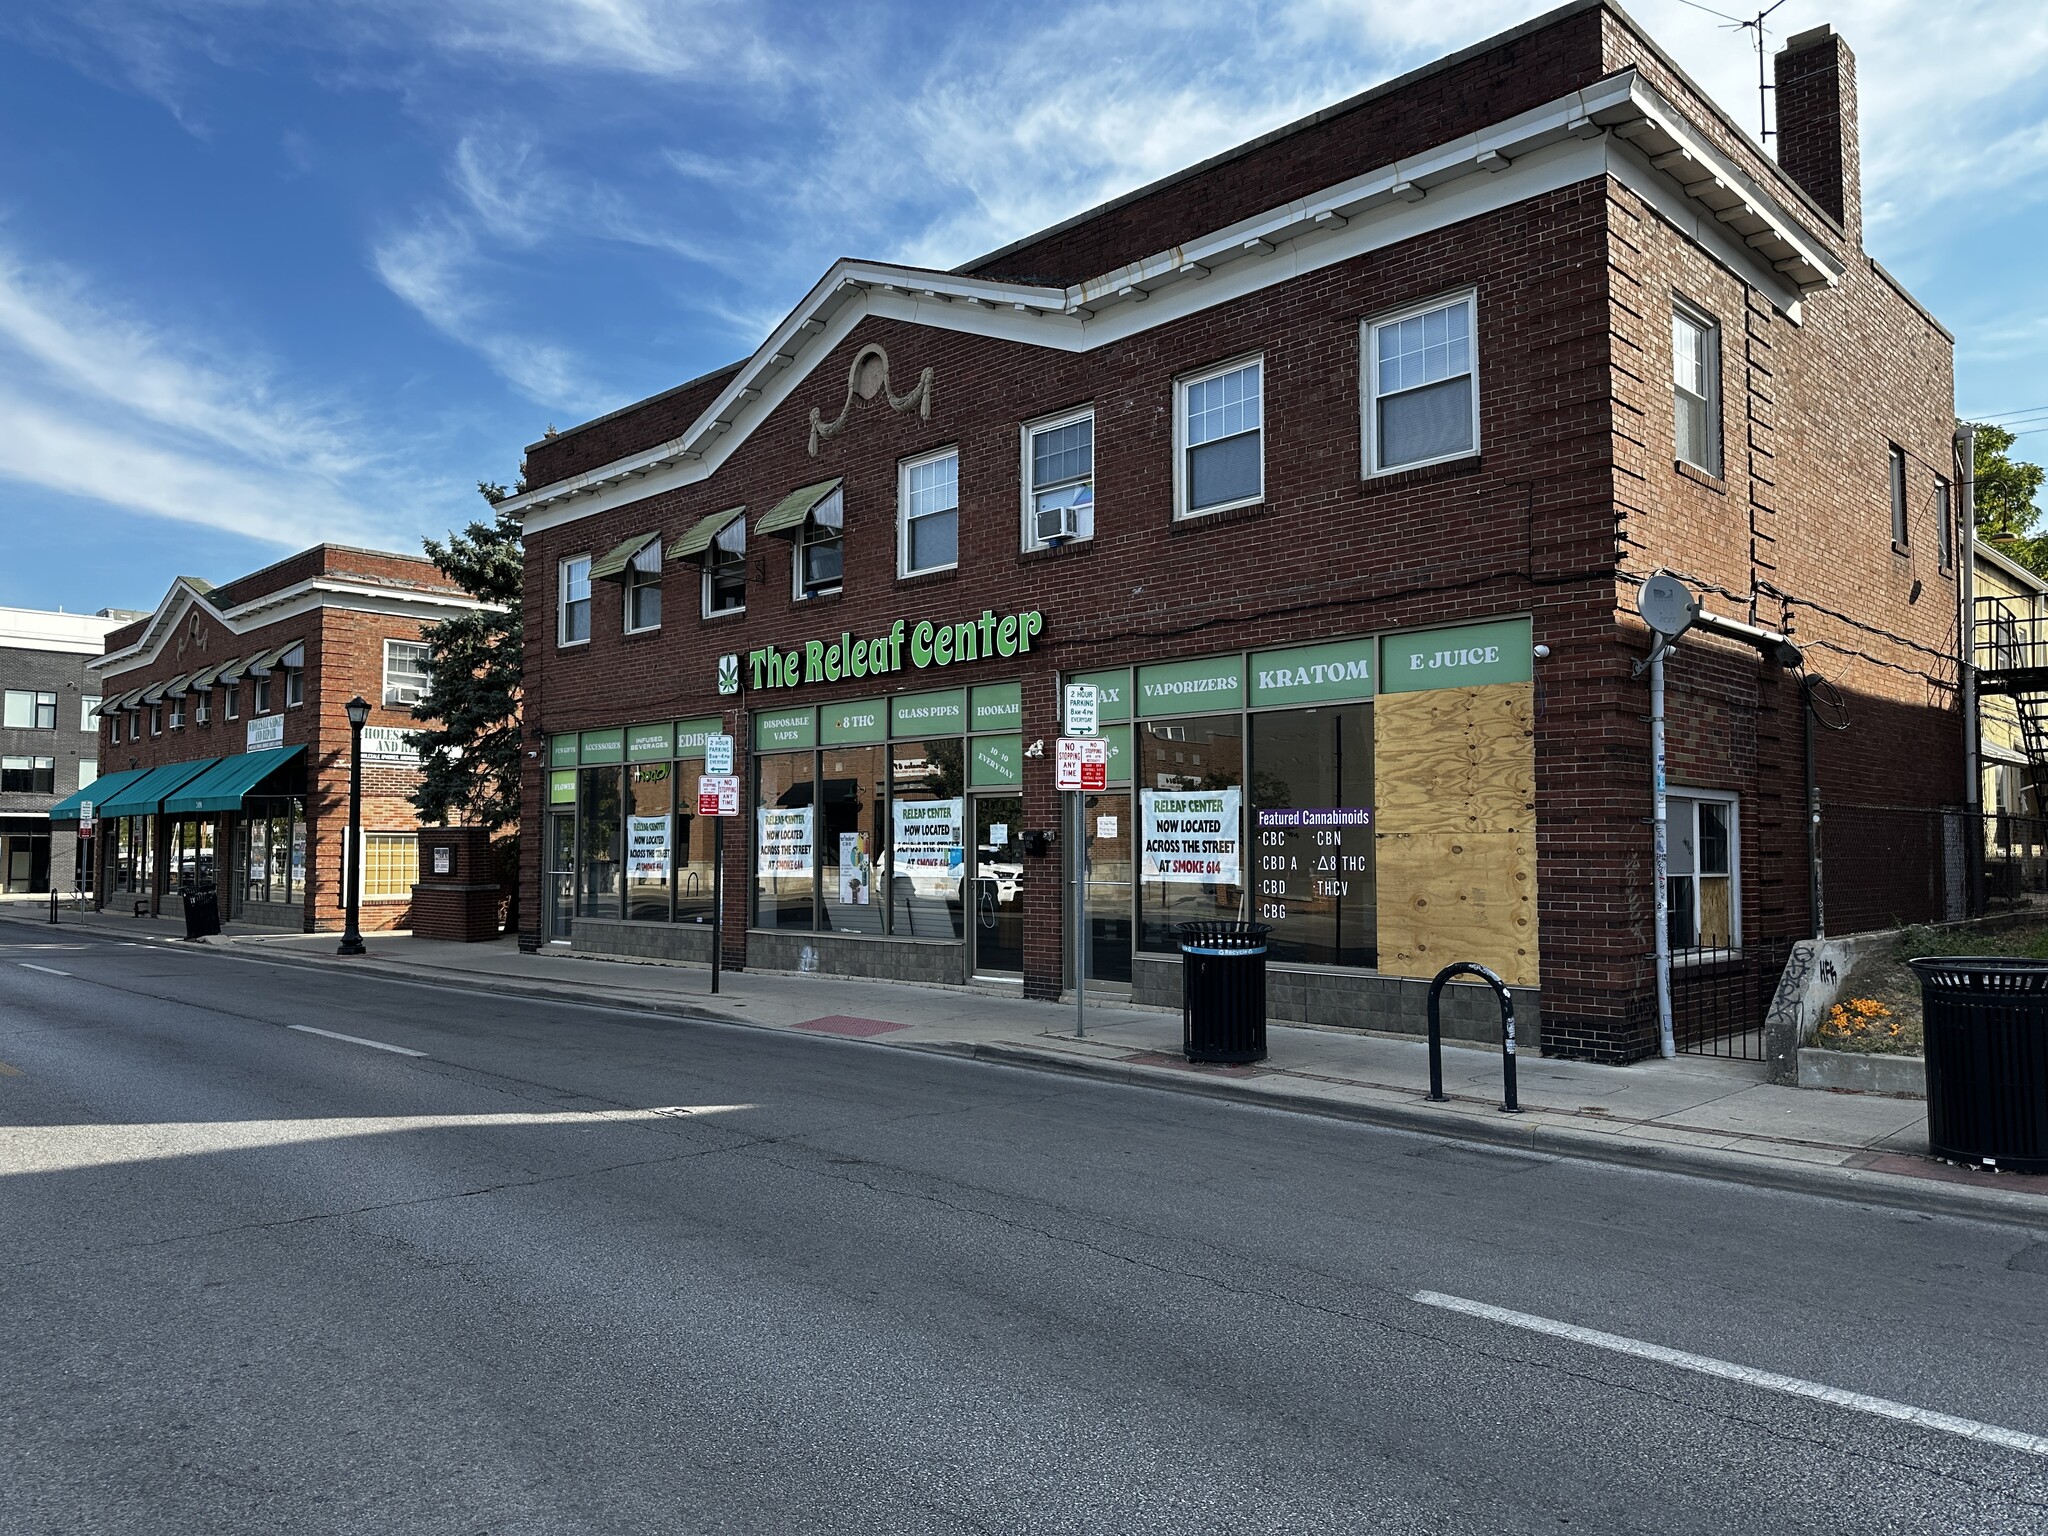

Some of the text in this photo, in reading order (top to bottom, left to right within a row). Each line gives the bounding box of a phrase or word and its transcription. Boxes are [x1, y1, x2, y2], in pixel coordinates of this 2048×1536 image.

[750, 610, 1042, 690] The Releaf Center
[1410, 646, 1500, 670] E JUICE
[1258, 660, 1369, 689] KRATOM
[1144, 676, 1238, 697] VAPORIZERS
[1098, 688, 1120, 702] AX
[898, 706, 959, 718] GLASS PIPES
[977, 704, 1019, 716] HOOKAH
[764, 717, 810, 729] DISPOSABLE
[843, 715, 874, 728] 8 THC
[774, 731, 798, 740] VAPES
[376, 740, 398, 752] AND
[585, 742, 621, 751] ACCESSORIES
[630, 742, 668, 750] BEVERAGES
[1065, 743, 1075, 751] NO
[990, 747, 998, 756] 10
[1001, 753, 1009, 762] 10
[1059, 752, 1080, 760] STOPPING
[978, 752, 1015, 779] EVERY DAY
[554, 782, 575, 791] FLOWER
[1154, 799, 1224, 812] RELEAF CENTER
[903, 807, 951, 820] RELEAF CENTER
[1259, 809, 1369, 825] Featured Cannabinoids
[765, 815, 805, 825] RELEAF CENTER
[1156, 820, 1221, 832] NOW LOCATED
[634, 822, 665, 831] RELEAF CENTER
[904, 825, 920, 836] NOW
[922, 825, 950, 835] LOCATED
[634, 836, 664, 844] NOW LOCATED
[766, 830, 804, 840] NOW LOCATED
[1262, 831, 1285, 846] CBC
[1317, 831, 1341, 846] CBN
[761, 845, 811, 855] ACROSS THE STREET
[1146, 840, 1235, 853] ACROSS THE STREET
[630, 849, 645, 858] ACROSS
[768, 860, 803, 870] AT SMOKE 614
[906, 859, 915, 869] AT
[1159, 860, 1221, 874] AT SMOKE 614
[1263, 856, 1297, 870] CBD A
[1342, 856, 1366, 871] THC
[1263, 880, 1286, 894] CBD
[1318, 880, 1348, 896] THCV
[1263, 904, 1286, 919] CBG
